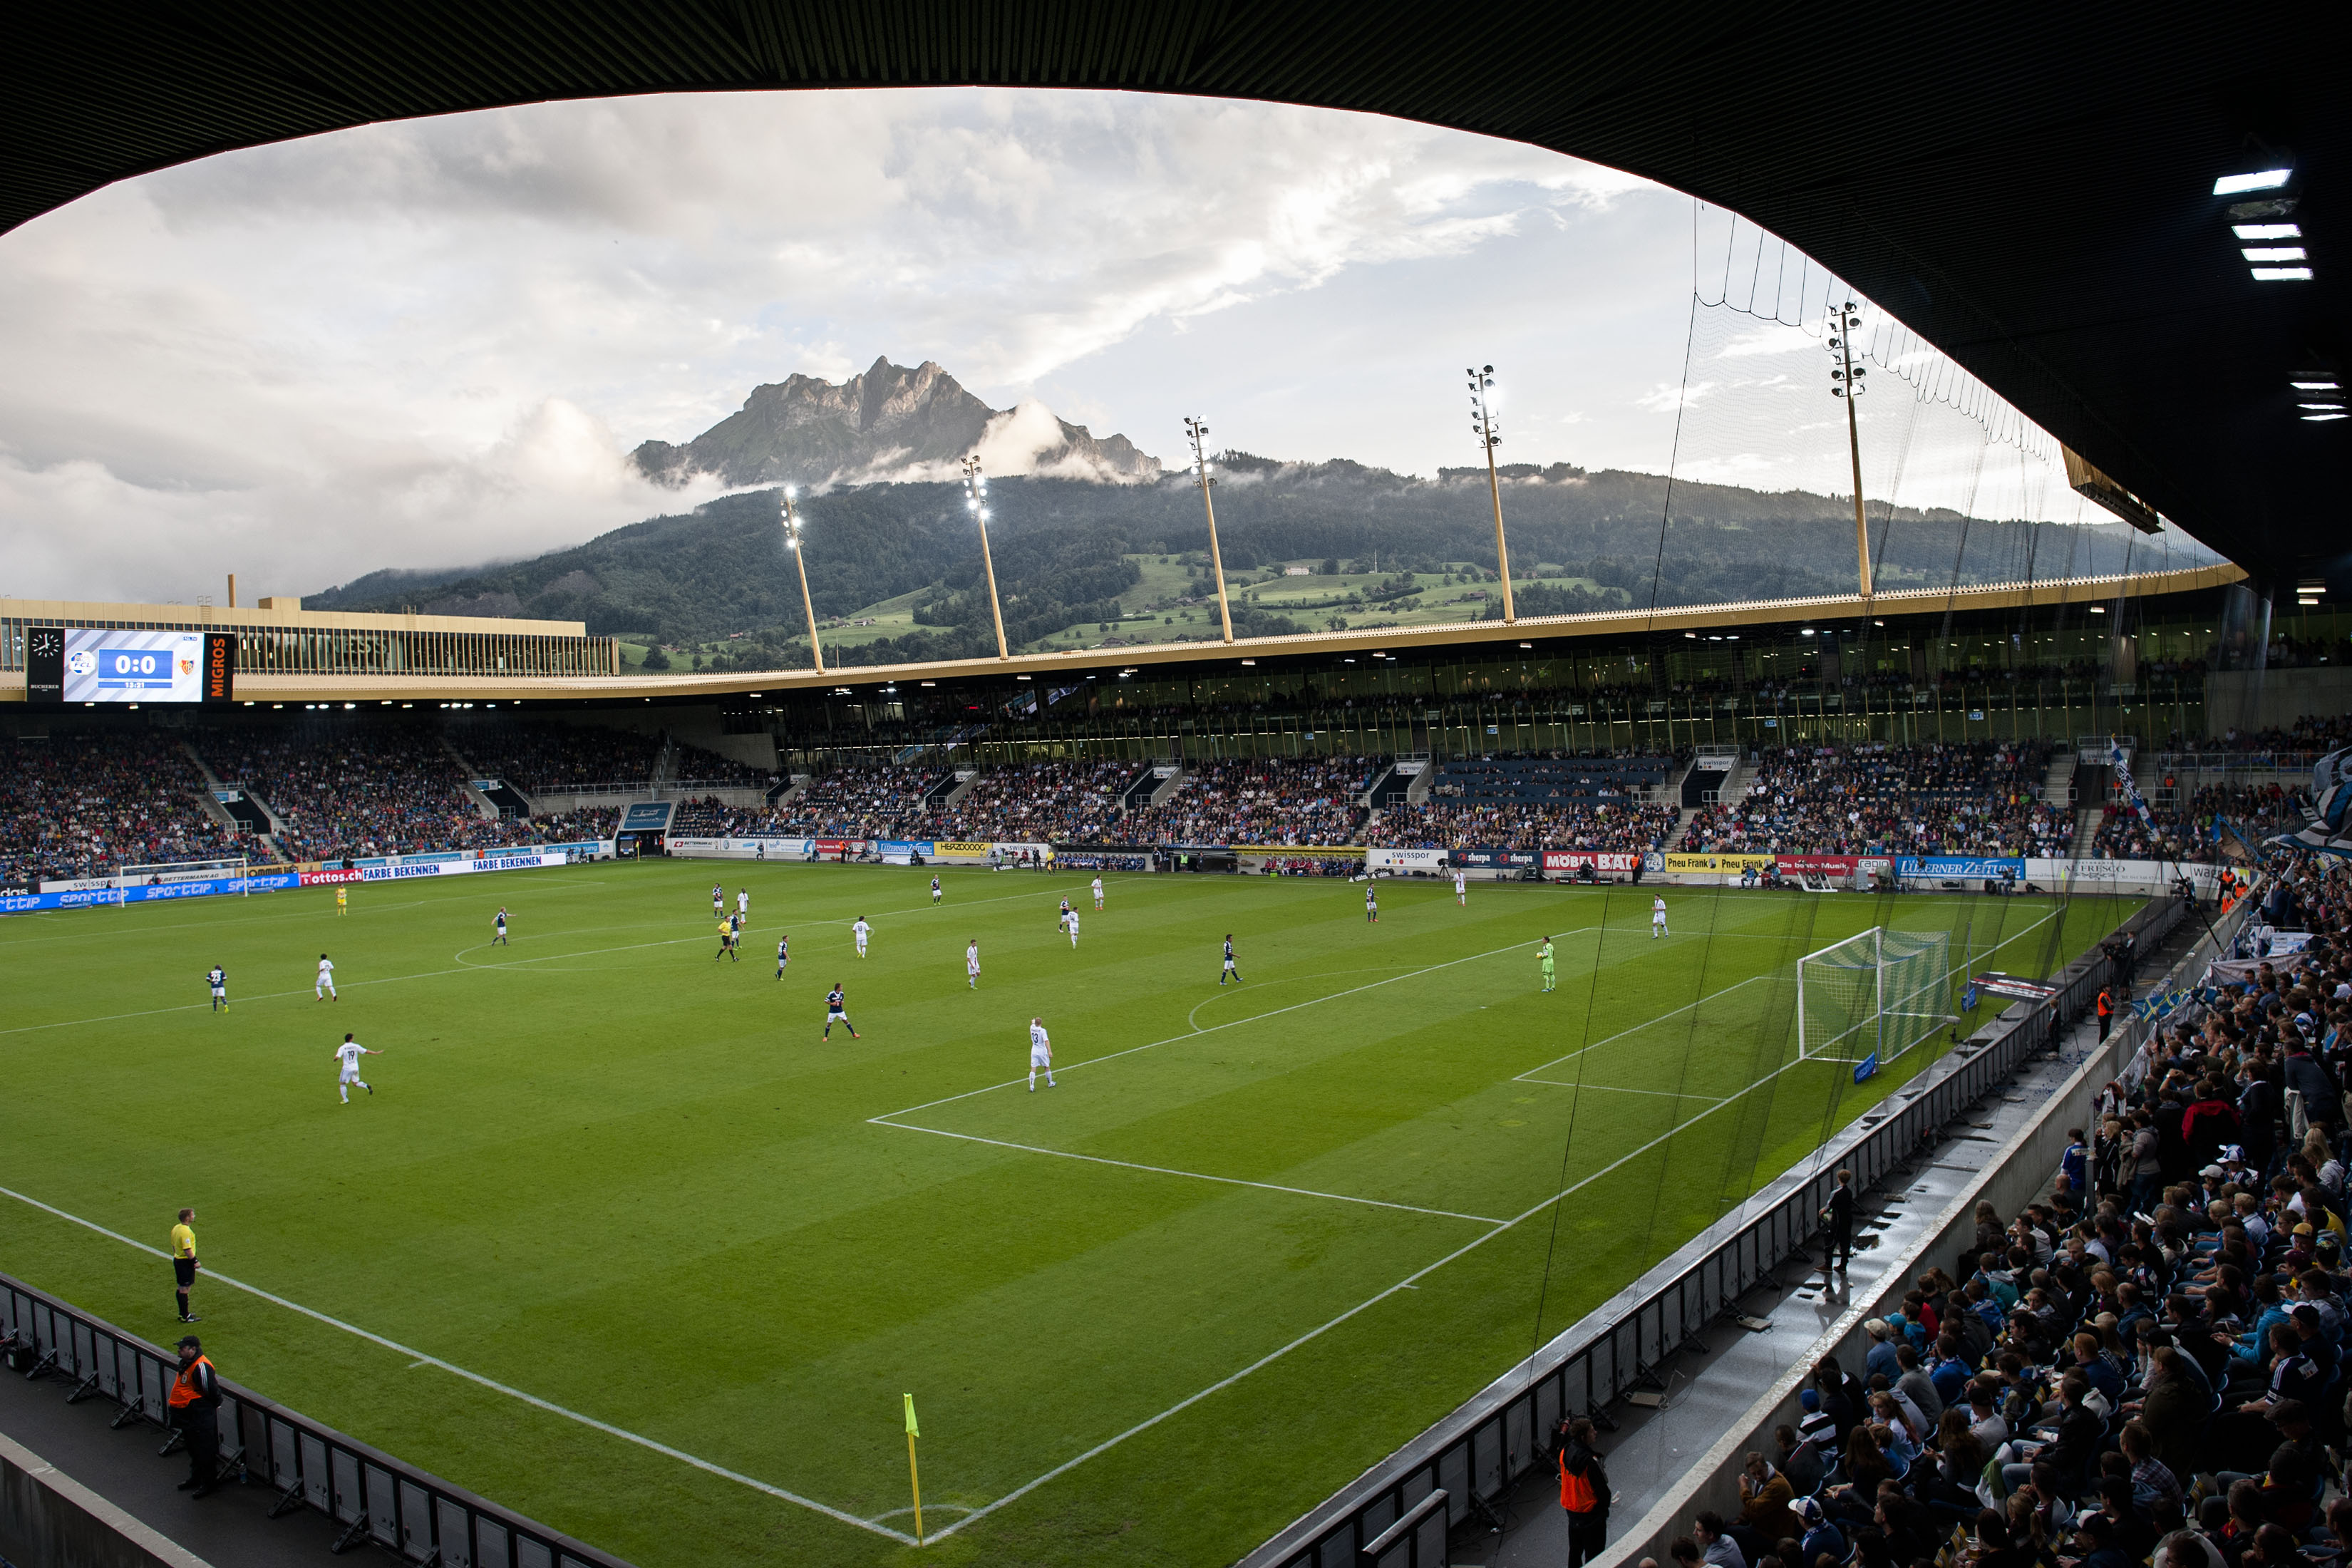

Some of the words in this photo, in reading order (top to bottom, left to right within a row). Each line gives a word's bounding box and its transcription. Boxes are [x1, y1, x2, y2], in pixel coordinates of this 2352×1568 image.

[115, 654, 156, 674] 0:0
[211, 639, 225, 696] MIGROS
[418, 855, 460, 864] Versicherung
[1391, 850, 1430, 860] swisspor
[1468, 852, 1490, 864] sherpa
[1510, 852, 1533, 865] sherpa
[473, 859, 498, 871] FARBE
[501, 855, 542, 868] BEKENNEN
[1546, 854, 1594, 868] MÖBEL
[1668, 857, 1686, 867] Pneu
[1688, 858, 1708, 868] Frank
[1721, 859, 1740, 869] Pneu
[1742, 859, 1763, 869] Frank
[363, 867, 391, 880] FARBE
[395, 864, 440, 877] BEKENNEN
[2080, 865, 2125, 874] FRESCO
[311, 870, 363, 884] ottos.ch
[73, 878, 118, 889] swsspr
[212, 974, 222, 982] 23
[1031, 1032, 1038, 1043] 13
[348, 1050, 355, 1061] 19
